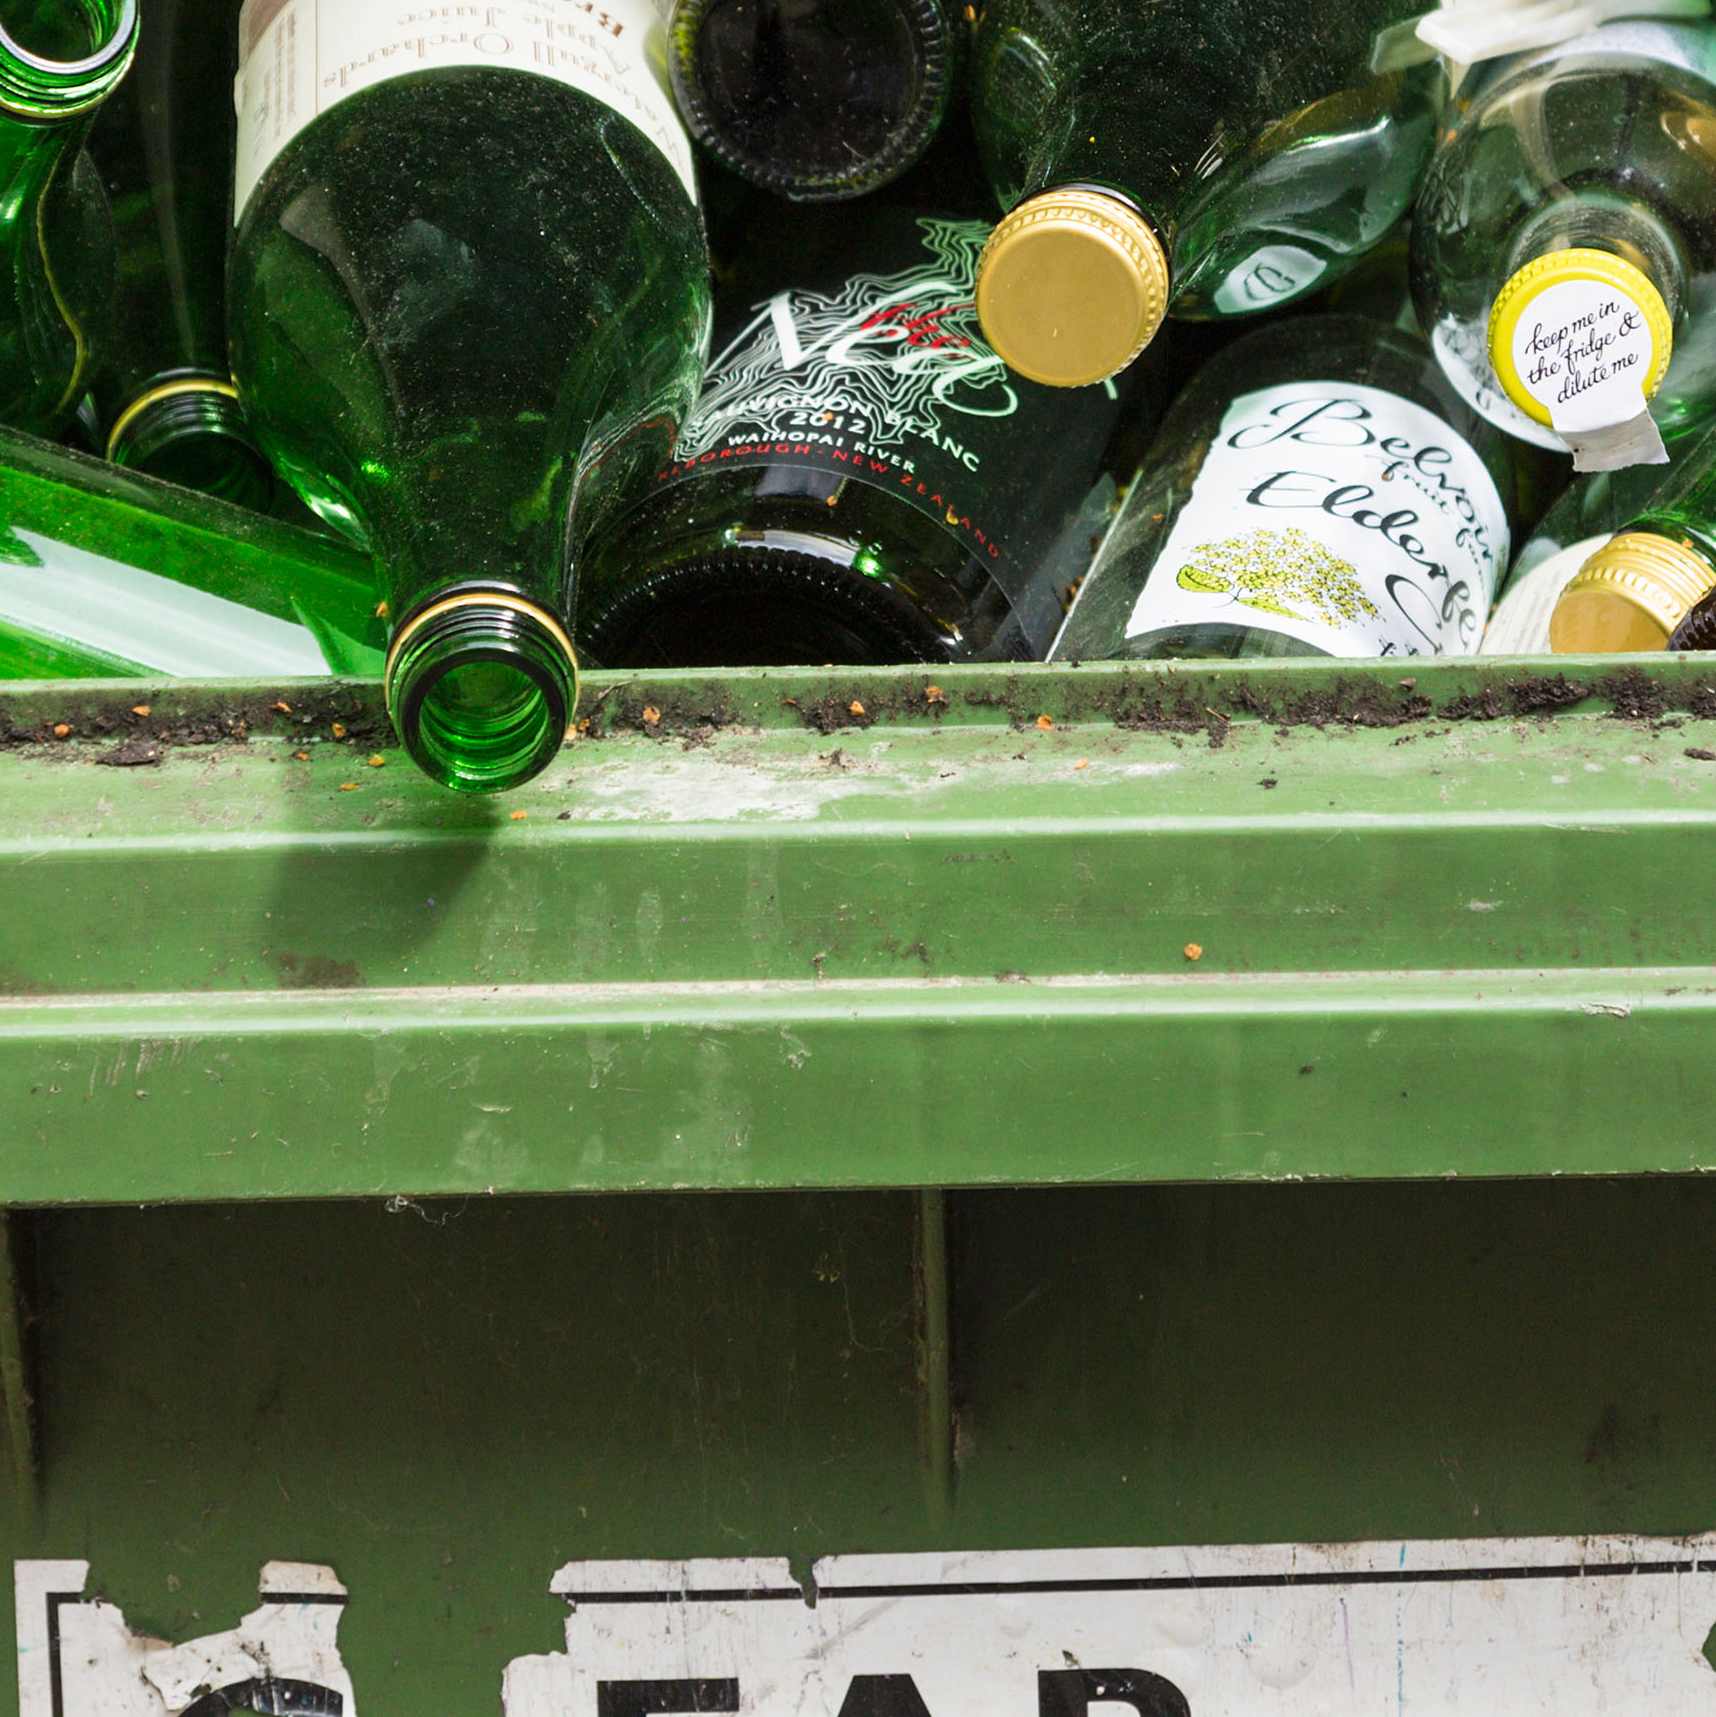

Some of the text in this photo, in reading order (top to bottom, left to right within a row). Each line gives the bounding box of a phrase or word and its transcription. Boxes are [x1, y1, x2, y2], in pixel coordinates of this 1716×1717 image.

[323, 32, 514, 90] Orchards
[395, 5, 632, 76] Apple Juice
[704, 280, 1019, 418] Ned
[1525, 299, 1620, 356] keep me in
[1528, 309, 1642, 385] the fridge &
[1557, 351, 1639, 404] dilute me
[689, 394, 981, 473] SAUVIGNON BLANC
[728, 430, 916, 475] WAIHOPAI RIVER
[789, 411, 868, 436] 2012
[833, 449, 891, 474] NEW
[899, 474, 1000, 560] ZEALAND
[1226, 398, 1495, 570] Belvoir
